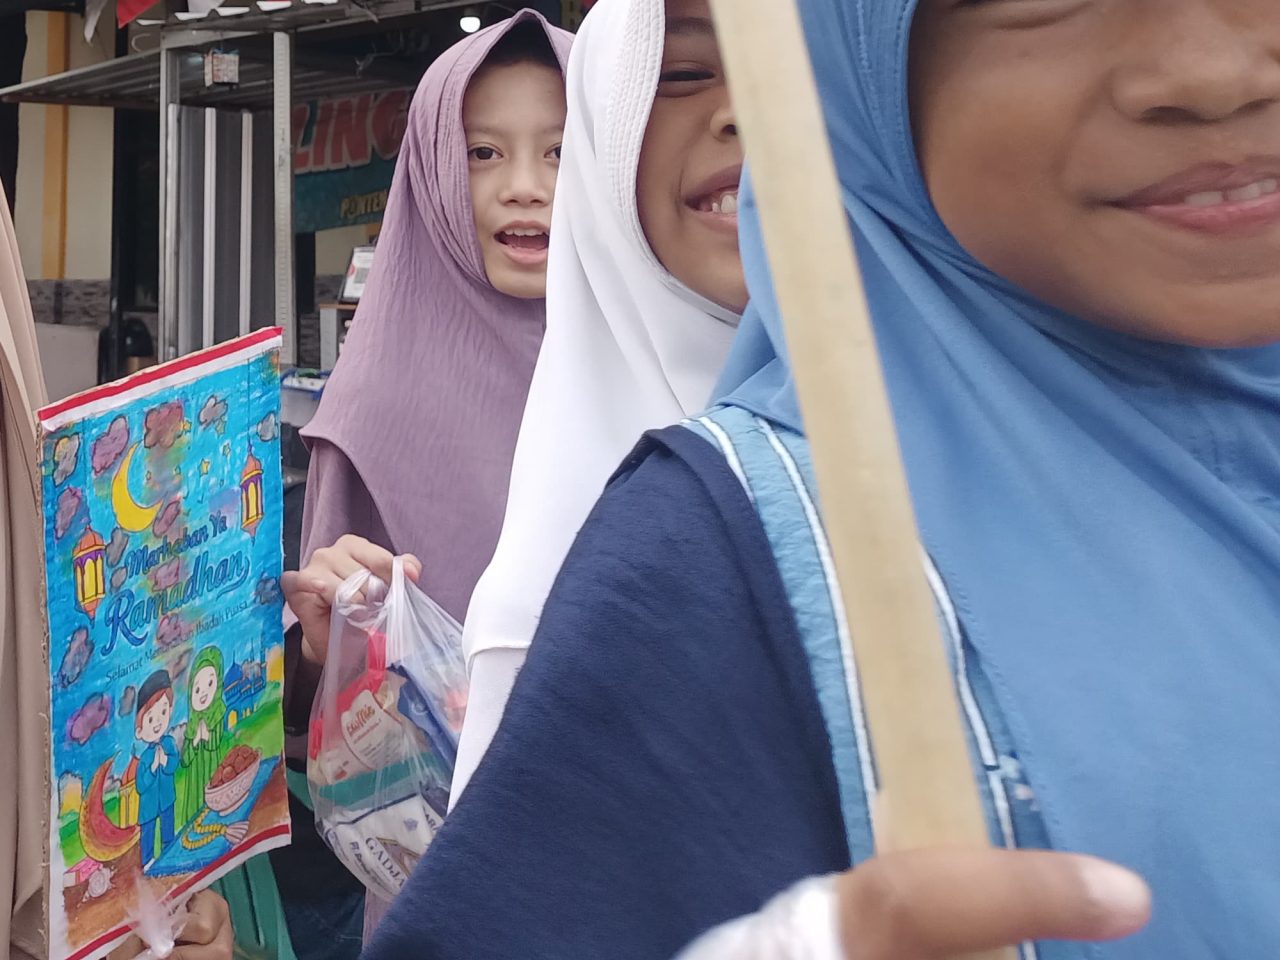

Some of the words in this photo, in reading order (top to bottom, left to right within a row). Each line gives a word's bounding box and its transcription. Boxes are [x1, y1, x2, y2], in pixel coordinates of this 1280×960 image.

[124, 524, 210, 579] Marhaban
[209, 512, 227, 538] Ya
[101, 551, 249, 656] Ramadhan
